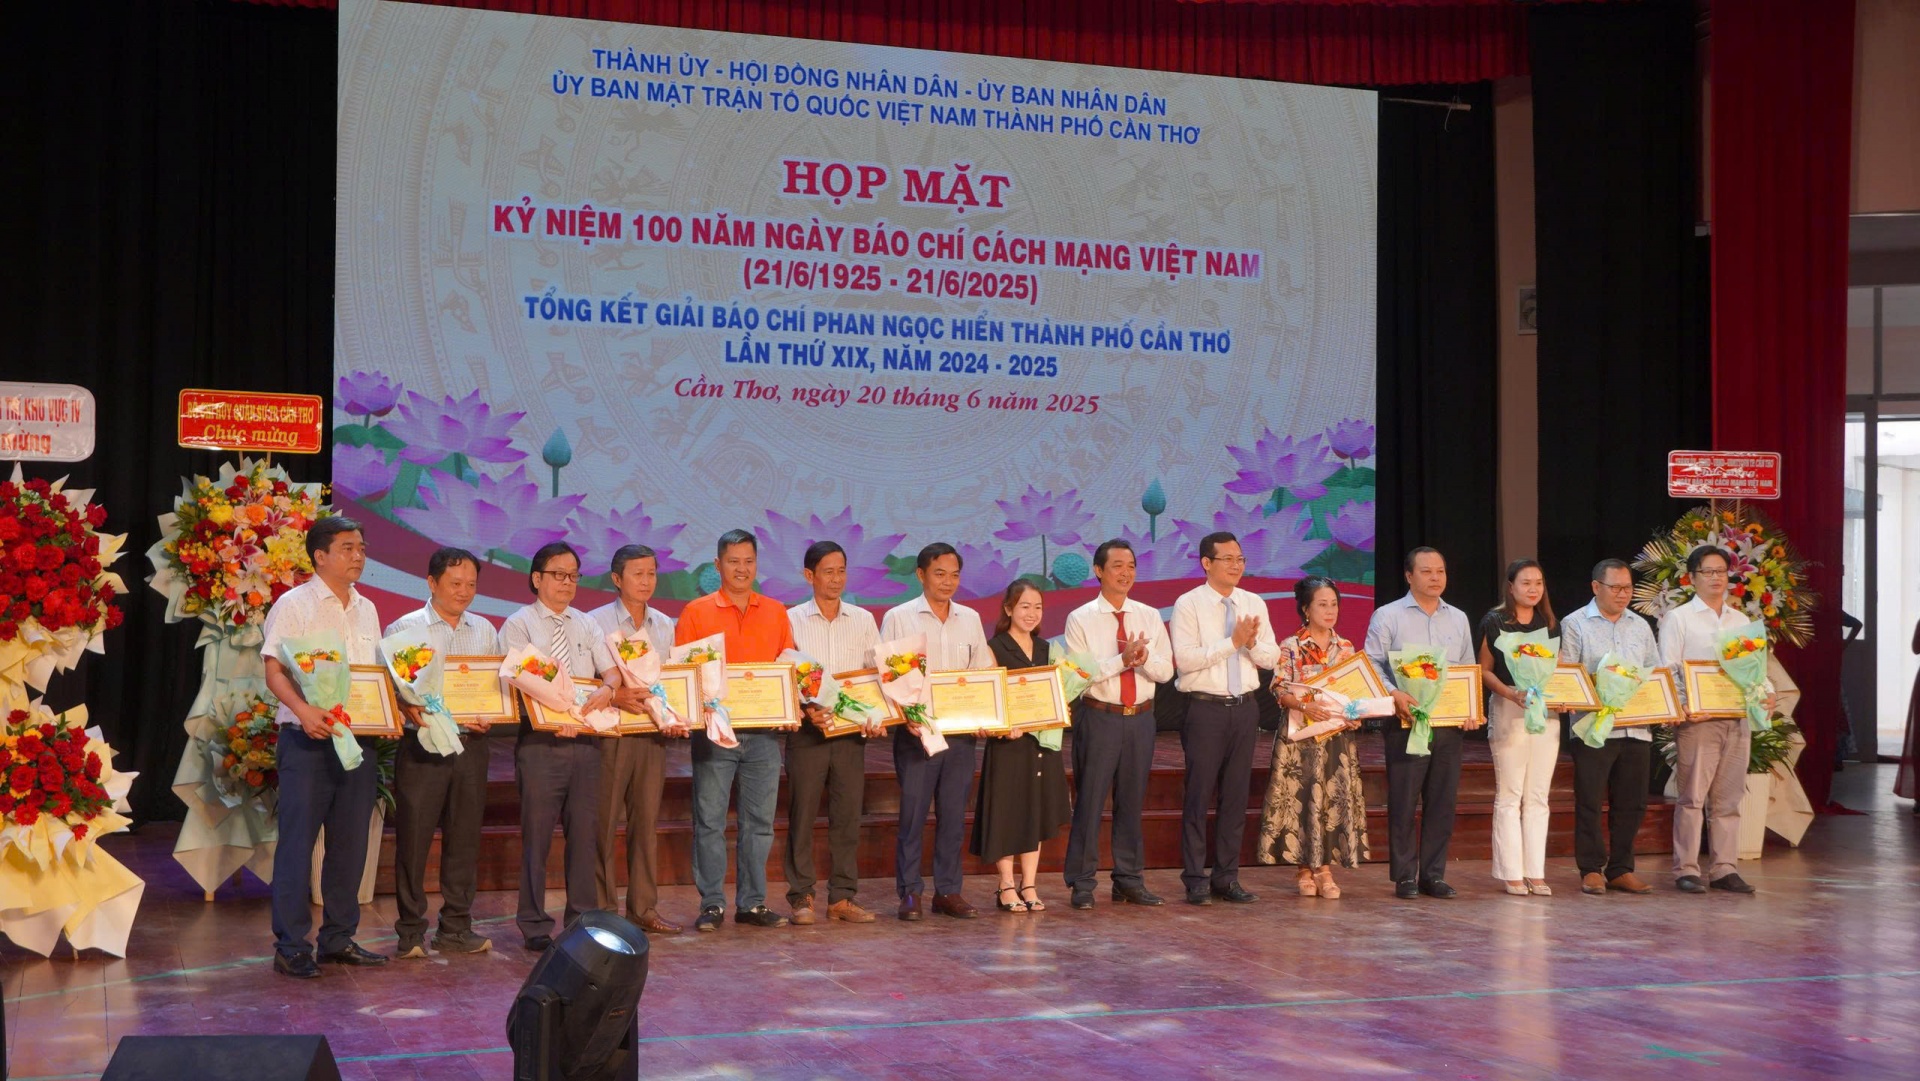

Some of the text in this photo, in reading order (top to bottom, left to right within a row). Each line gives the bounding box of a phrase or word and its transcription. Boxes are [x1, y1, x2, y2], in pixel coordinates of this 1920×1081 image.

[592, 47, 671, 75] THÀNH
[679, 52, 709, 77] ỦY
[730, 59, 768, 86] HỘI
[774, 62, 839, 88] ĐỒNG
[846, 68, 906, 94] NHÂN
[914, 74, 958, 98] DÂN
[978, 79, 1005, 102] ỦY
[1012, 86, 1054, 107] BAN
[1061, 88, 1118, 112] NHÂN
[1125, 92, 1166, 116] DÂN
[553, 71, 584, 96] ỦY
[591, 78, 639, 100] BAN
[647, 82, 695, 108] MẶT
[702, 86, 762, 113] TRẬN
[806, 94, 870, 118] QUỐC
[877, 101, 923, 126] VIỆT
[930, 105, 976, 126] NAM
[983, 108, 1053, 133] THÀNH
[1061, 115, 1103, 137] PHỐ
[1109, 119, 1150, 141] CẦN
[1158, 124, 1200, 145] THƠ
[783, 160, 1011, 213] HỌP MẶT
[494, 196, 1259, 280] KỶ NIỆM 100 NĂM NGÀY BÁO CHÍ CÁCH MẠNG VIỆT NAM
[744, 258, 1037, 305] (21/6/1925 - 21/6/2025)
[525, 287, 1231, 353] TỔNG KẾT GIẢI BÁO CHÍ PHAN NGỌC HIỂN THÀNH PHỐ CẦN THƠ
[725, 332, 1057, 377] LẦN THỨ XIX, NĂM 2024 - 2025
[24, 398, 45, 421] KHU
[71, 399, 81, 423] IV
[675, 374, 1099, 414] Cần Thơ, ngày 20 tháng 6 năm 2025
[0, 429, 52, 454] mừng
[203, 424, 299, 447] Chúc mừng
